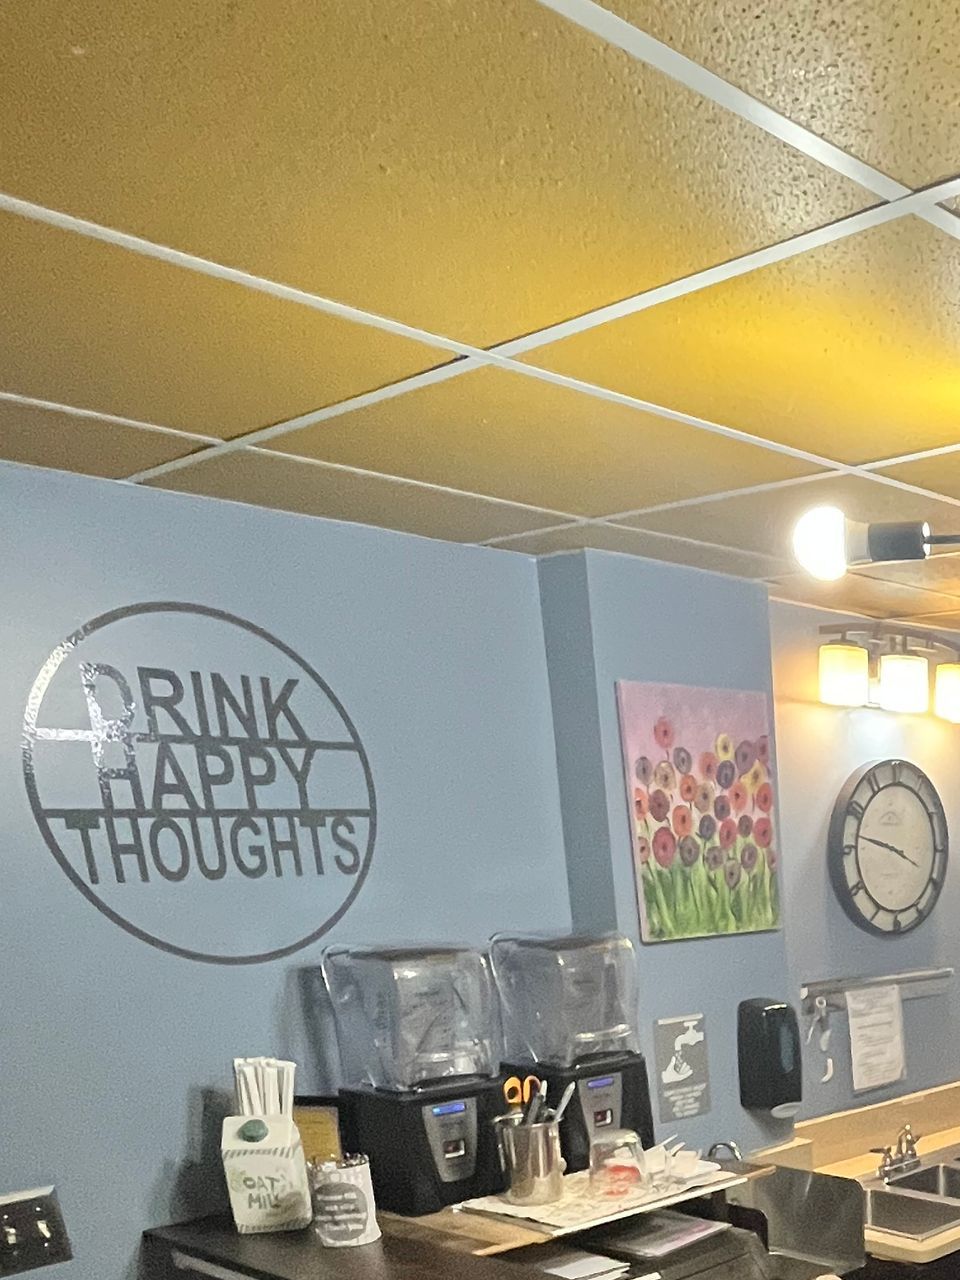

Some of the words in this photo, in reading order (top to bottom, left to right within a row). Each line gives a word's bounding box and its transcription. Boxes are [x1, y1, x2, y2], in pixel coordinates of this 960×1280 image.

[79, 661, 312, 744] DRINK
[93, 741, 317, 813] HAPPY
[64, 812, 362, 885] THOUGHTS
[243, 1175, 279, 1192] OAT
